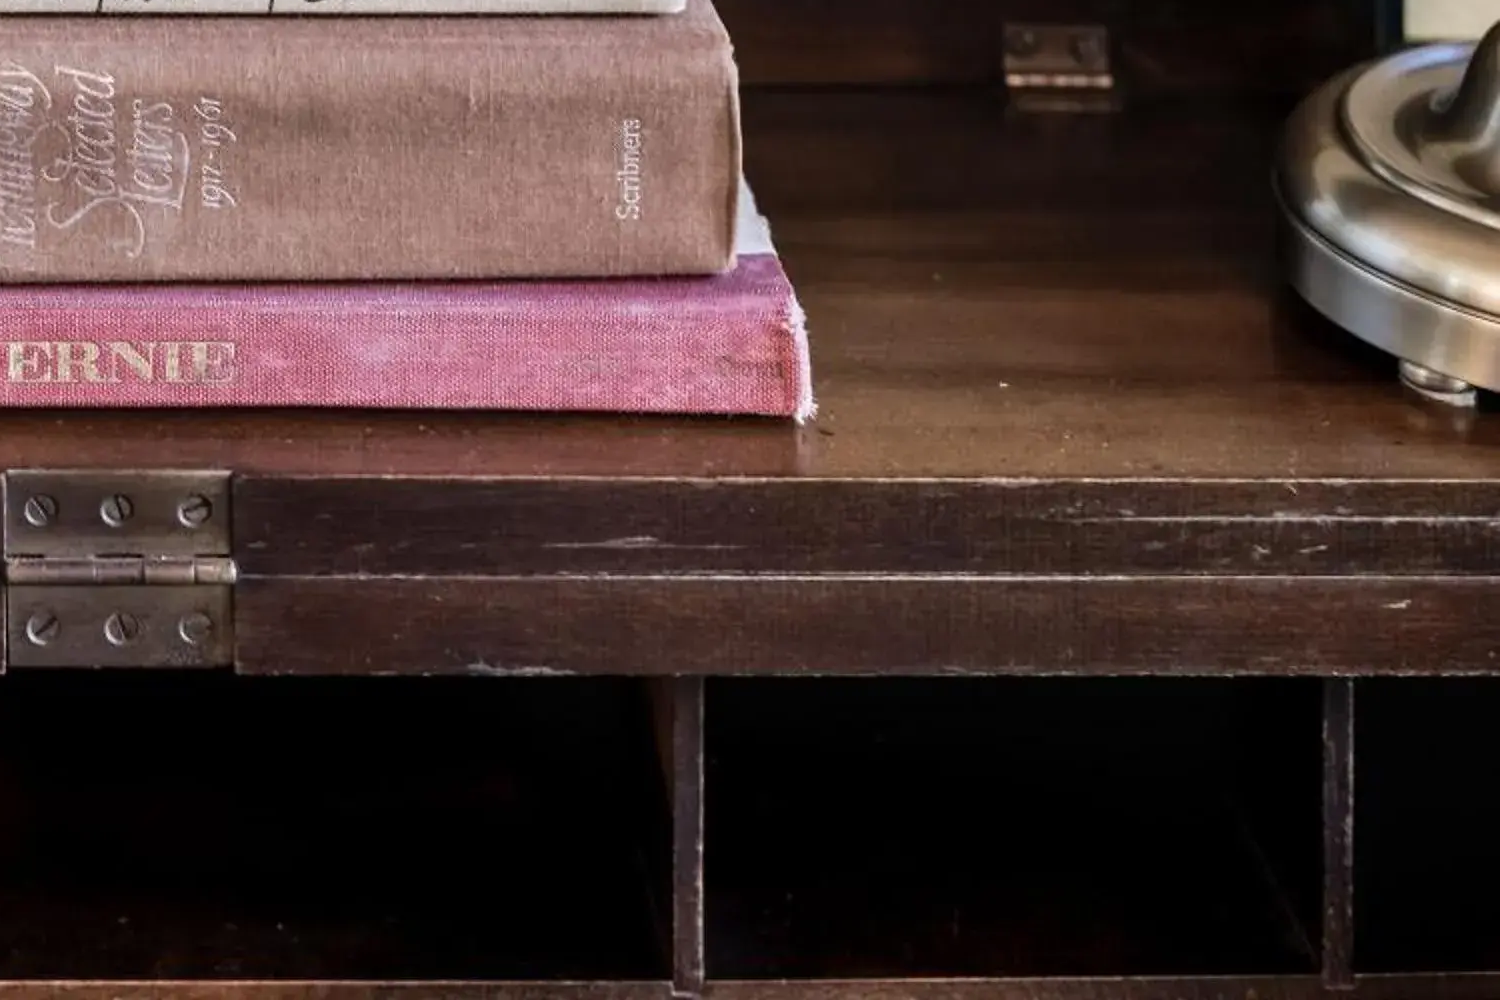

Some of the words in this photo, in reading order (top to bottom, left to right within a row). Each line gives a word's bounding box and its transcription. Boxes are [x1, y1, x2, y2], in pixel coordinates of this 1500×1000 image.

[43, 63, 145, 258] Selected
[118, 98, 192, 212] Letters
[615, 119, 641, 221] Scribners
[3, 340, 236, 384] ERNIE
